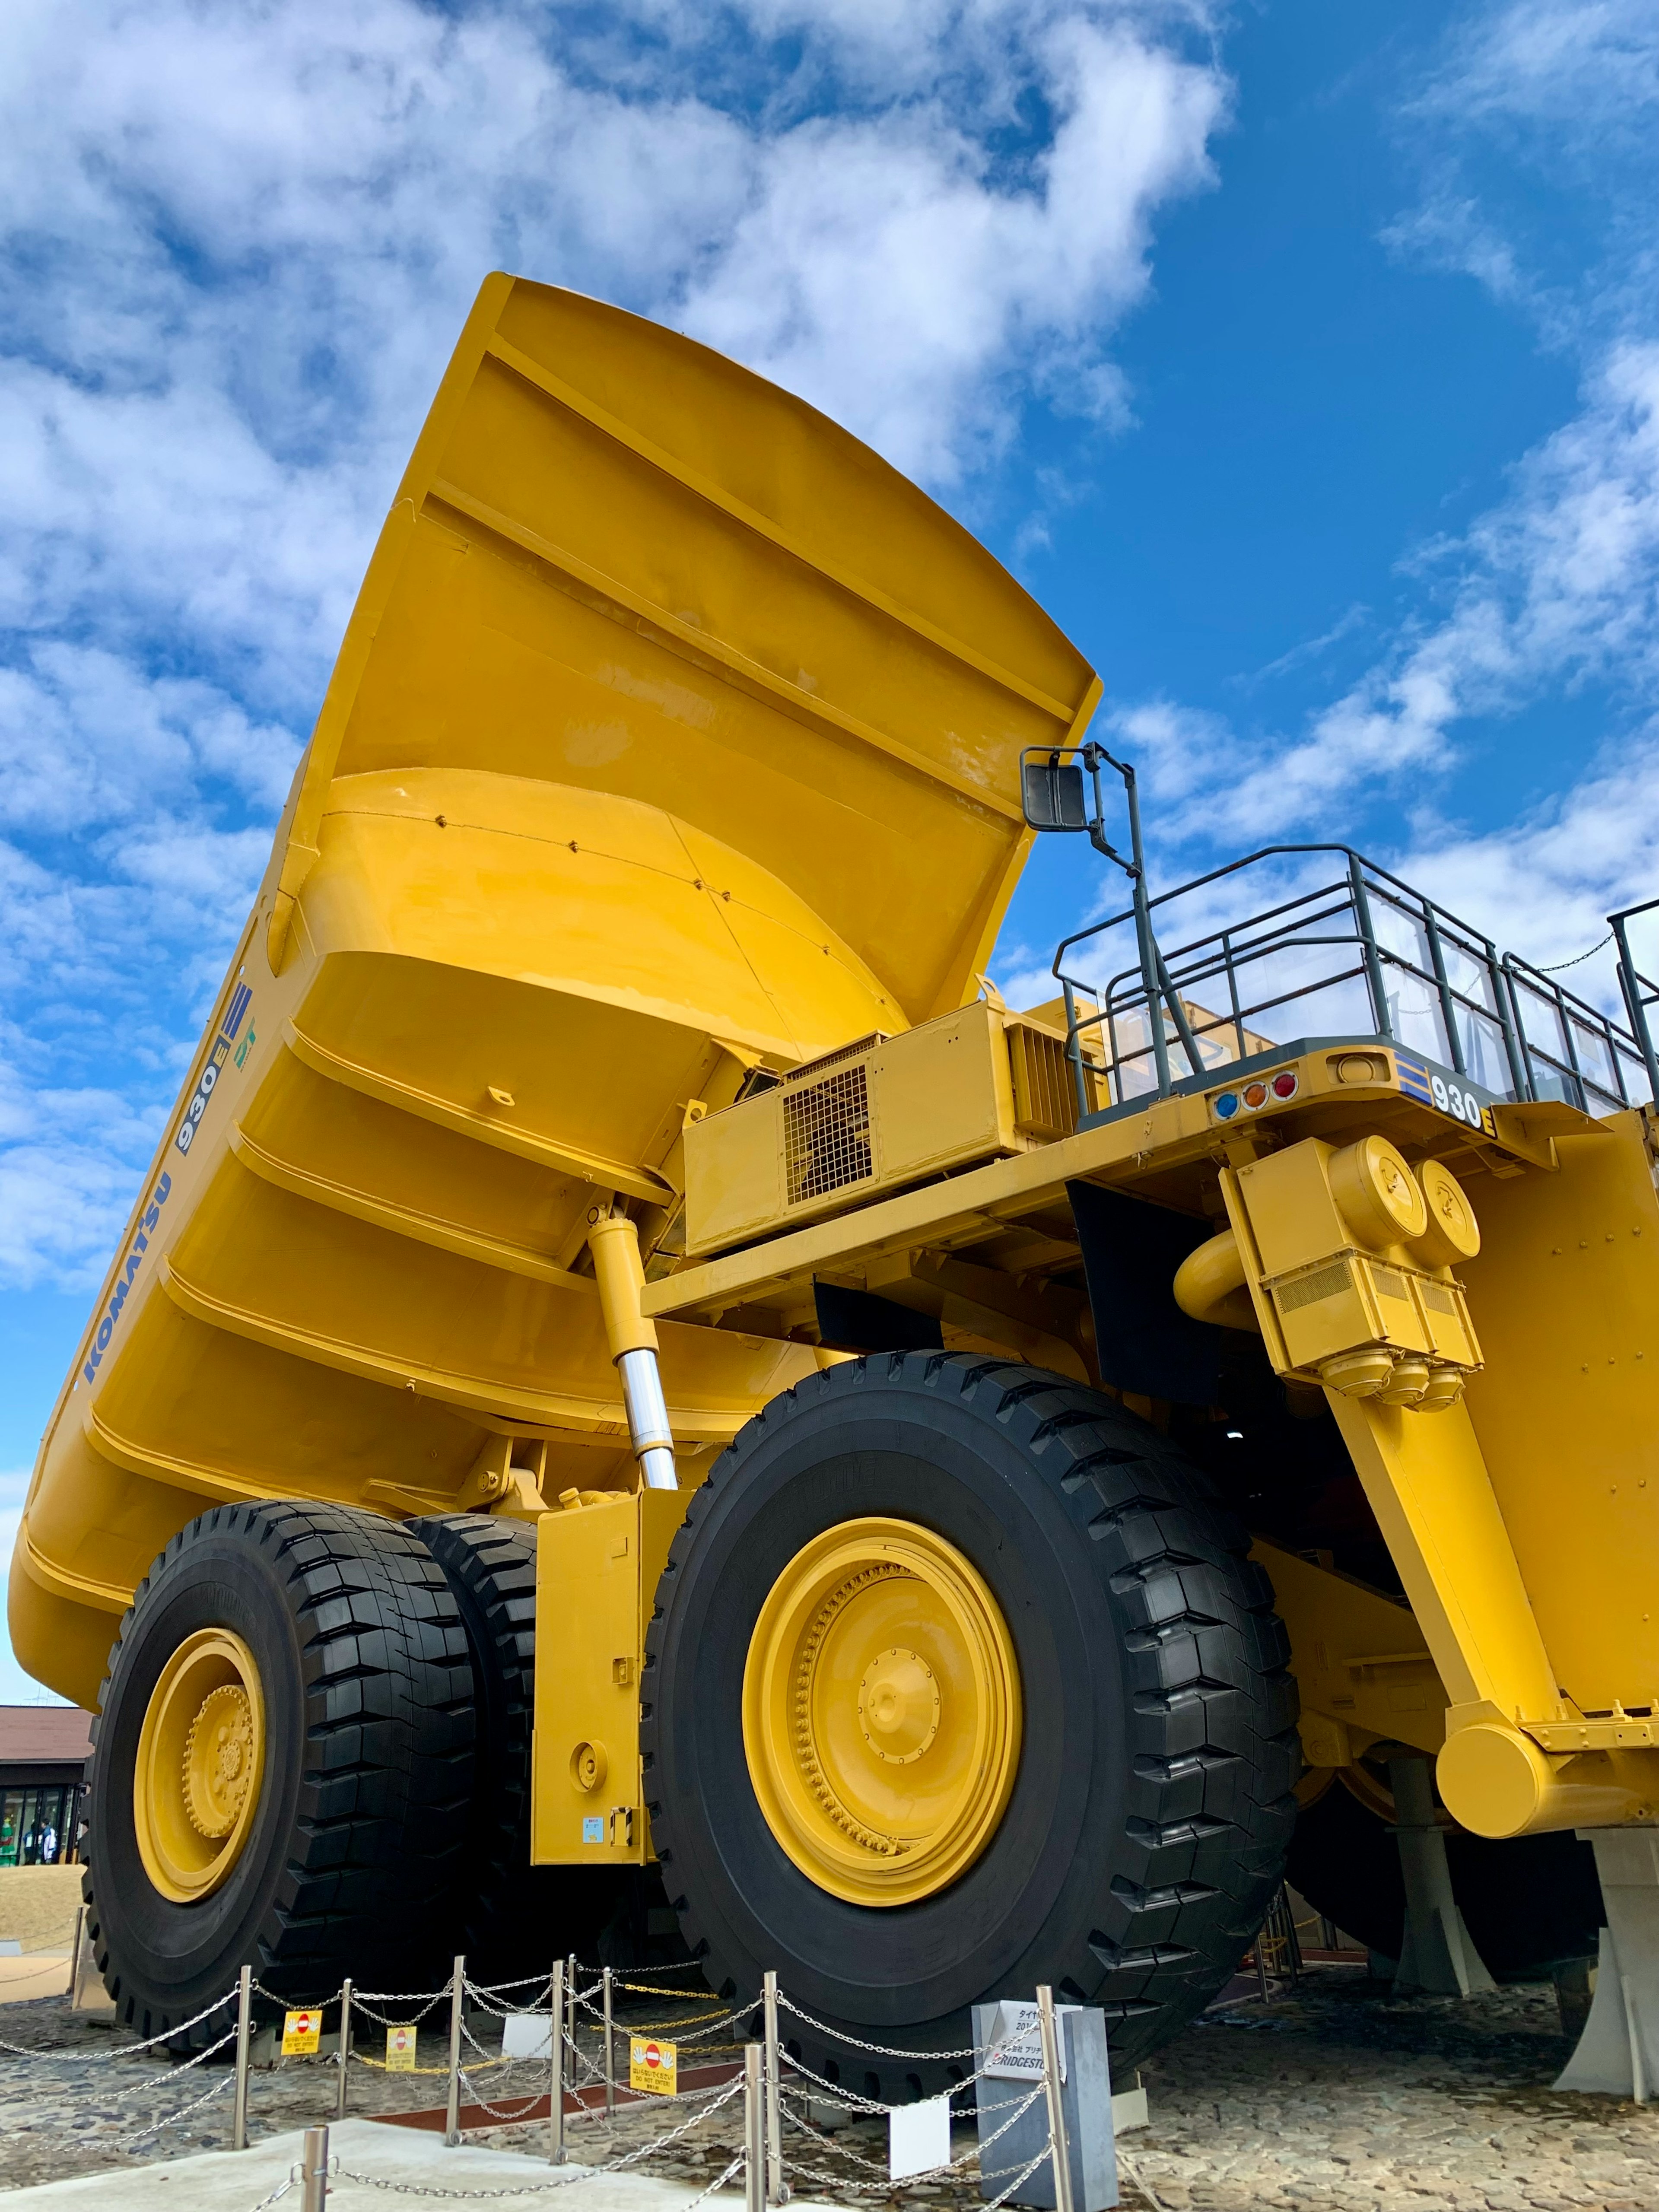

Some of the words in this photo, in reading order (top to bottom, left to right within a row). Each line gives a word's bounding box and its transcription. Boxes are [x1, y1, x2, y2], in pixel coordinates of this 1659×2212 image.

[178, 1043, 228, 1150] 930E
[1431, 1075, 1496, 1138] 930E
[83, 1171, 172, 1386] KOMATSU
